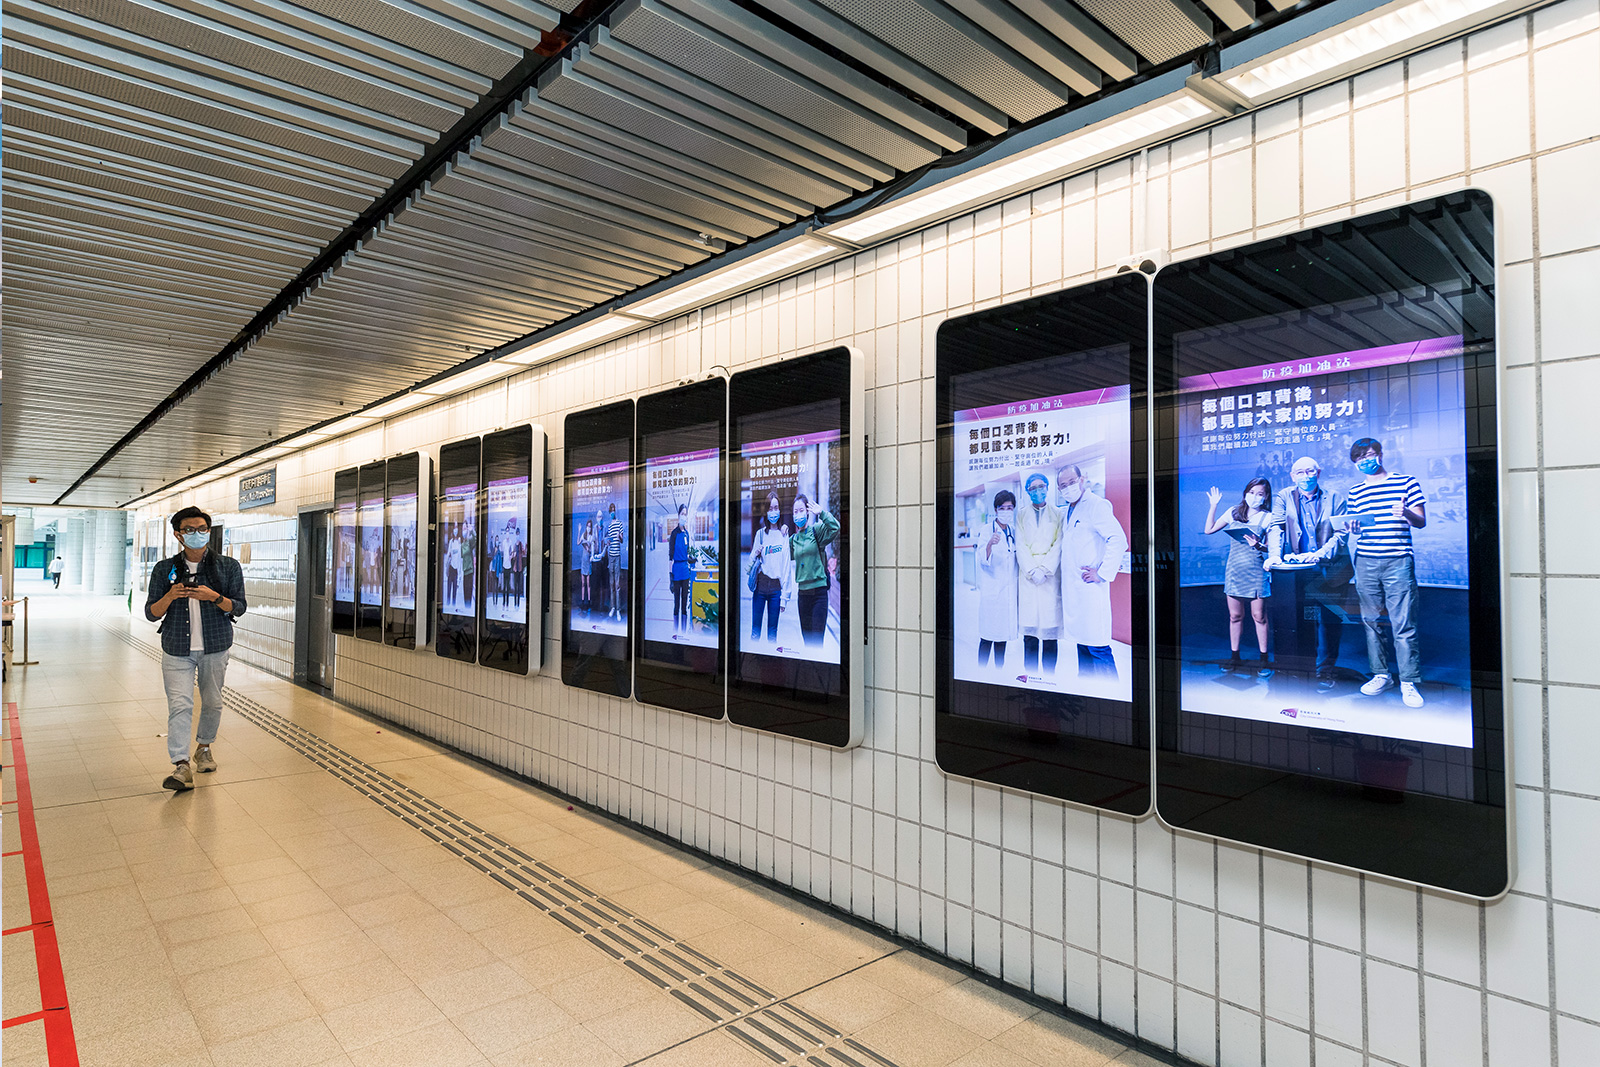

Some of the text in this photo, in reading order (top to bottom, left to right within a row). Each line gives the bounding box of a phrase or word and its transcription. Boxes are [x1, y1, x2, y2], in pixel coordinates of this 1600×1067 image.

[1262, 356, 1351, 380] 防疫加油站
[1007, 399, 1063, 415] 防疫加油站
